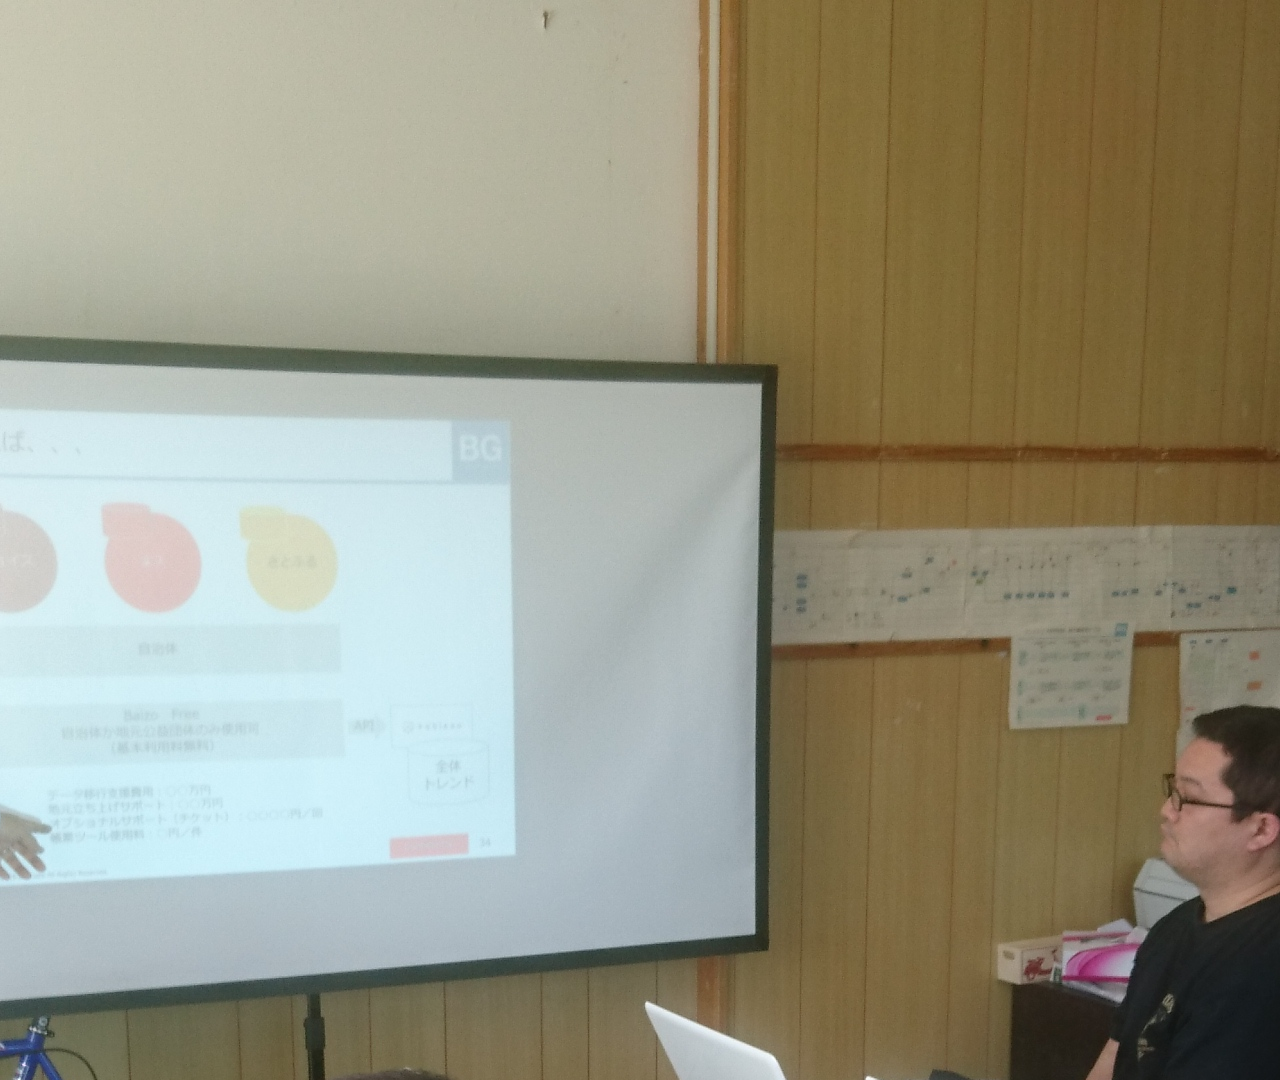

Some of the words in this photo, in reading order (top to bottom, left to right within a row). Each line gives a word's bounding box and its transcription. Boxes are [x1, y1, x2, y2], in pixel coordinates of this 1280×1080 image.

[459, 434, 502, 462] BG
[138, 642, 177, 656] 自治体
[171, 708, 200, 720] Free
[435, 758, 461, 774] 全体
[425, 775, 475, 791] トレンド
